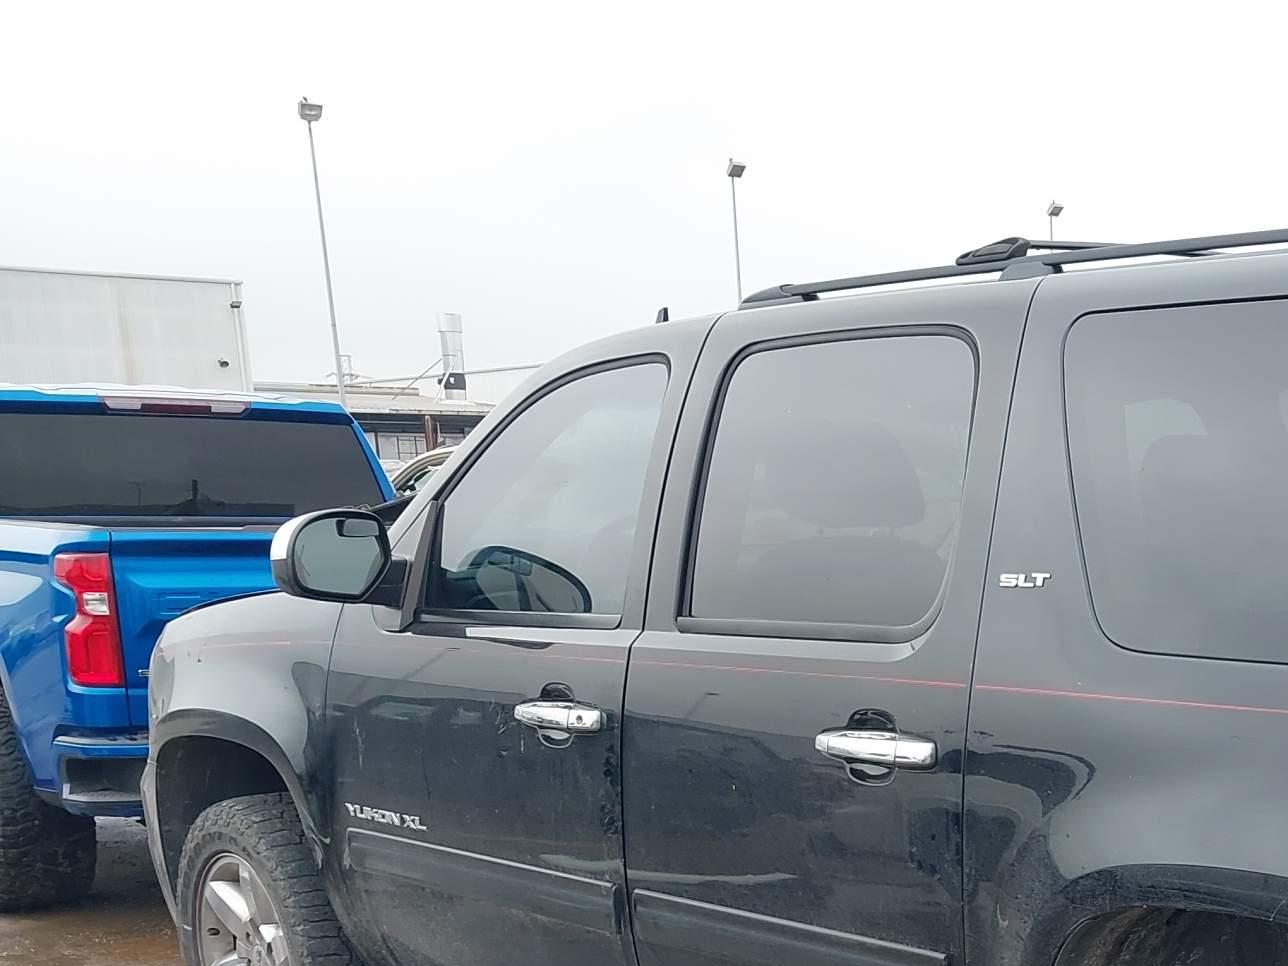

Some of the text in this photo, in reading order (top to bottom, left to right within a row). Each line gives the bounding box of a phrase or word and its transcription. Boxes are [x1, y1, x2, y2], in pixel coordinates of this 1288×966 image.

[999, 572, 1051, 588] SLT
[344, 802, 428, 831] YUKON XL
